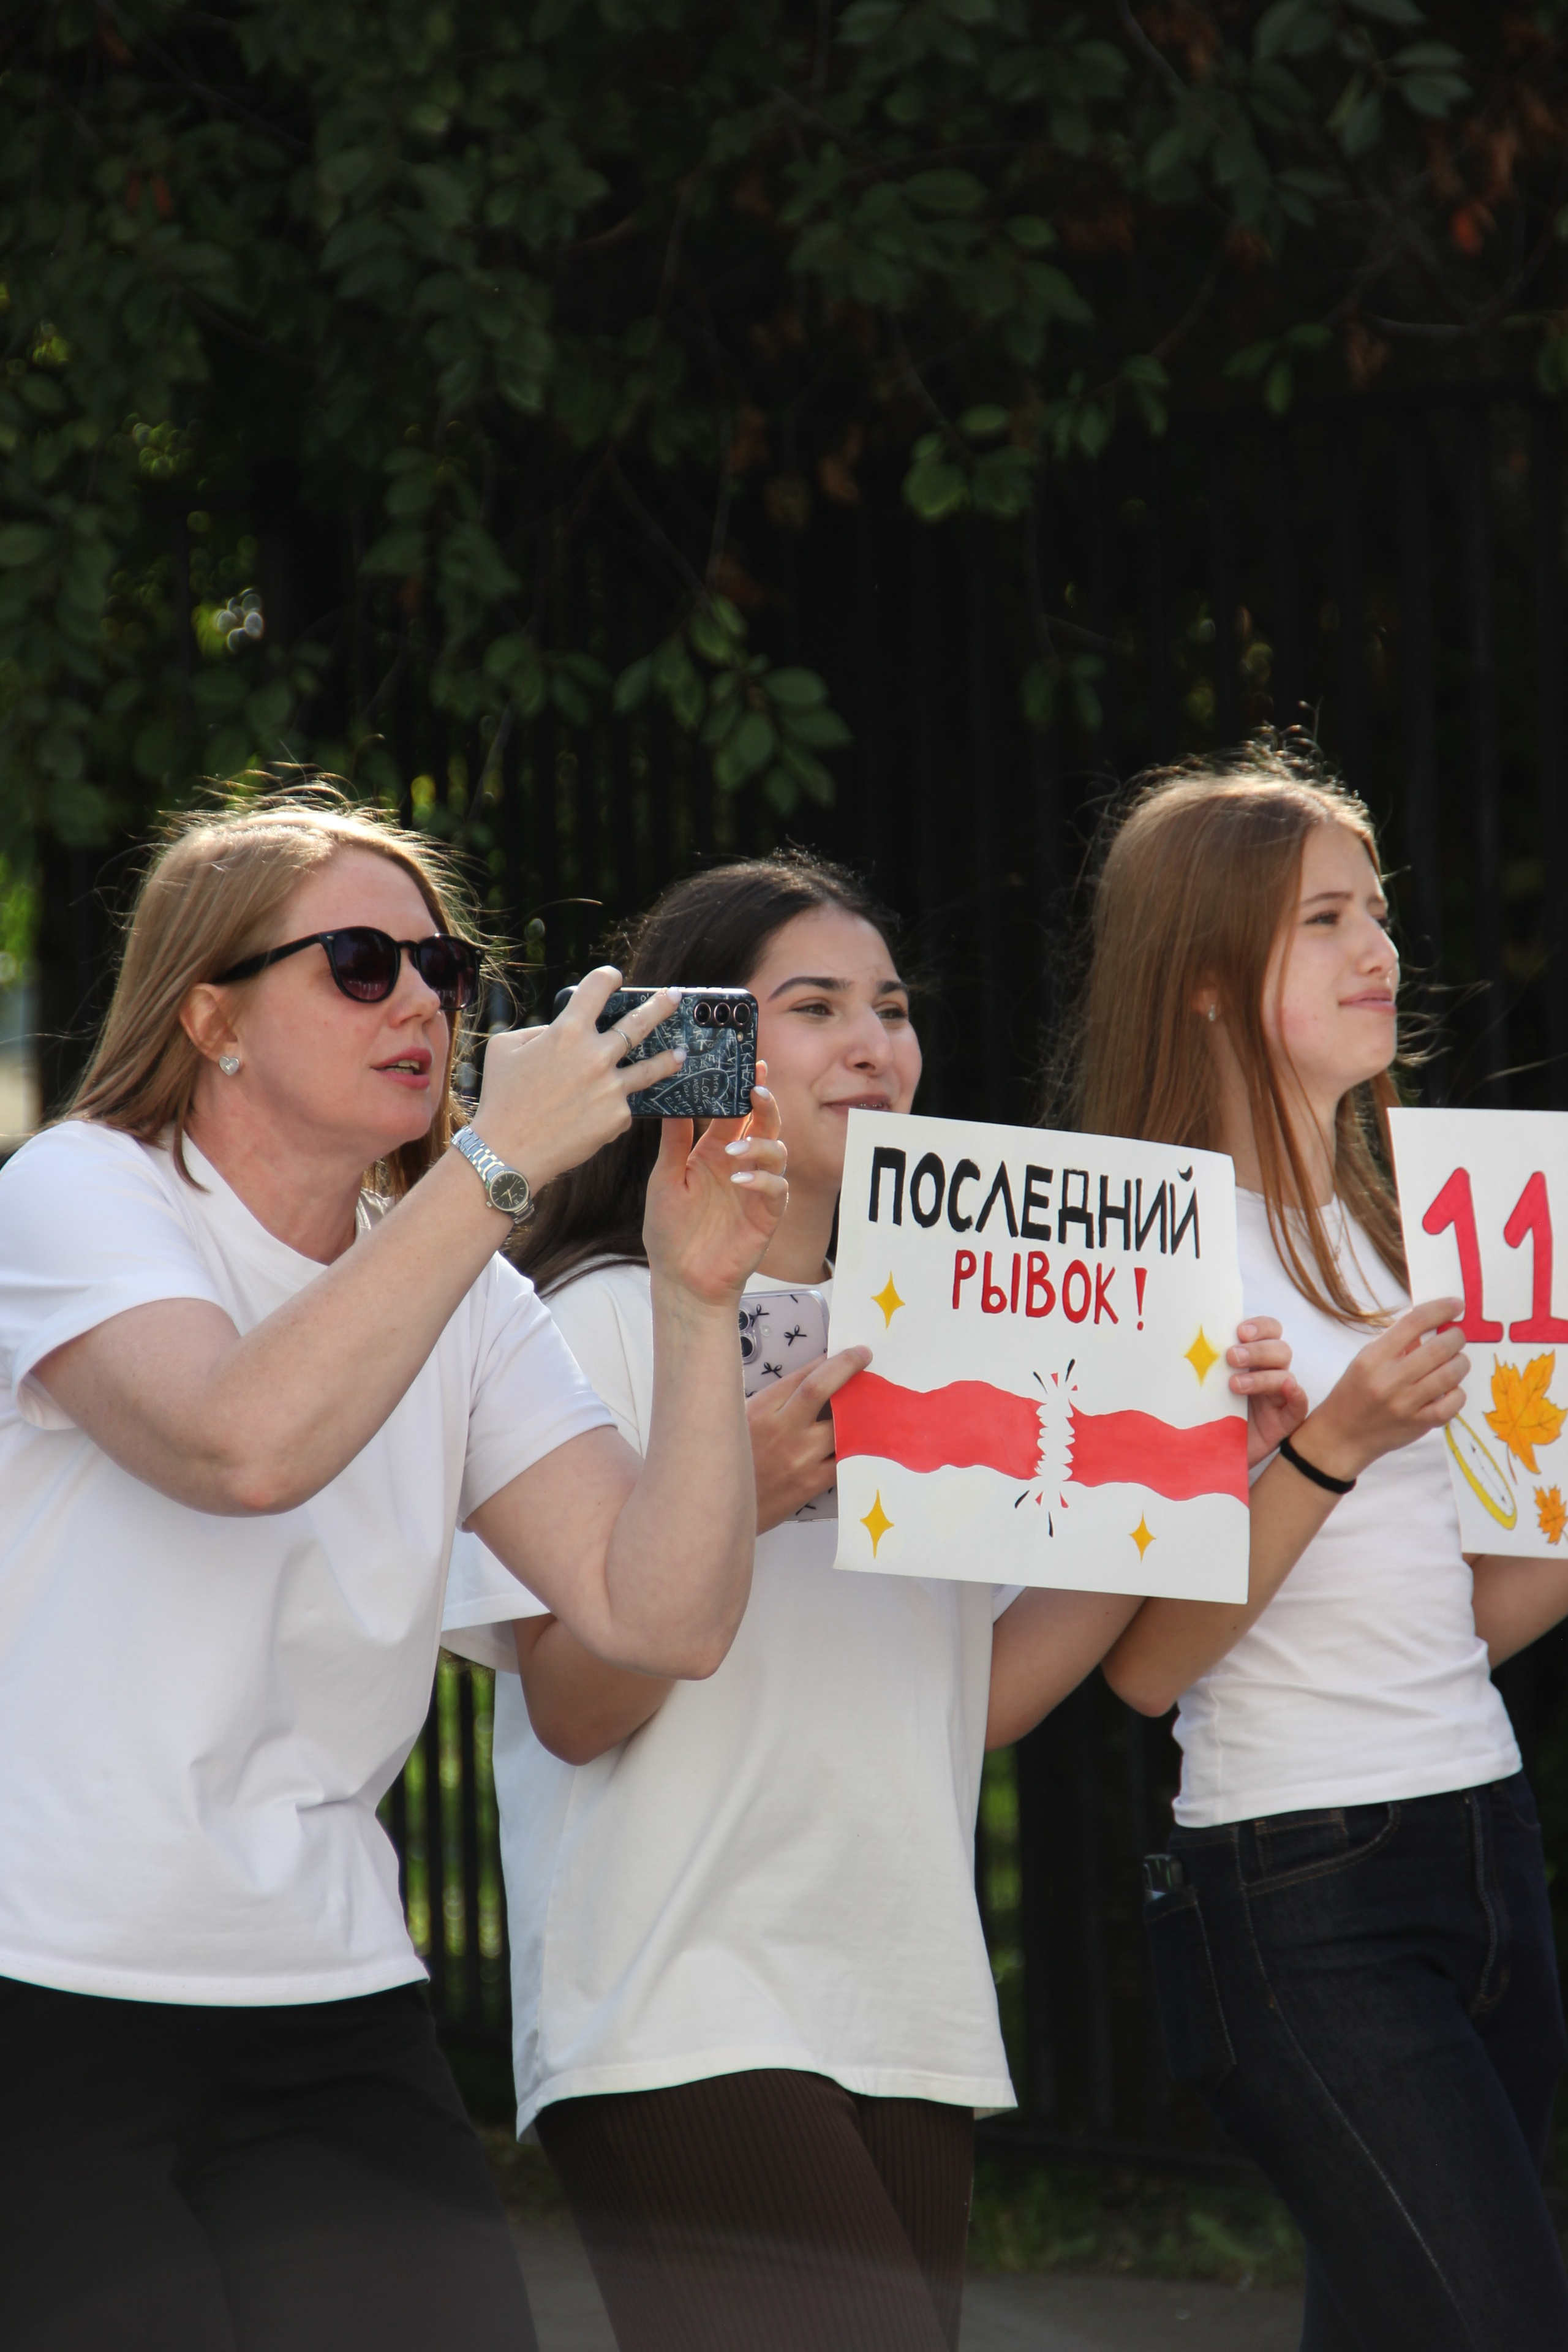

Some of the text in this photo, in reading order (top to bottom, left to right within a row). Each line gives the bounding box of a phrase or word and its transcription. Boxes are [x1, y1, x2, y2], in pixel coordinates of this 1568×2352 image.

[701, 1077, 712, 1109] LOVE
[741, 1063, 755, 1099] HEAD
[868, 1146, 1200, 1259] ПОСЛЕДНИЙ
[952, 1249, 1148, 1331] РЫВОК!
[1422, 1166, 1568, 1343] 11
